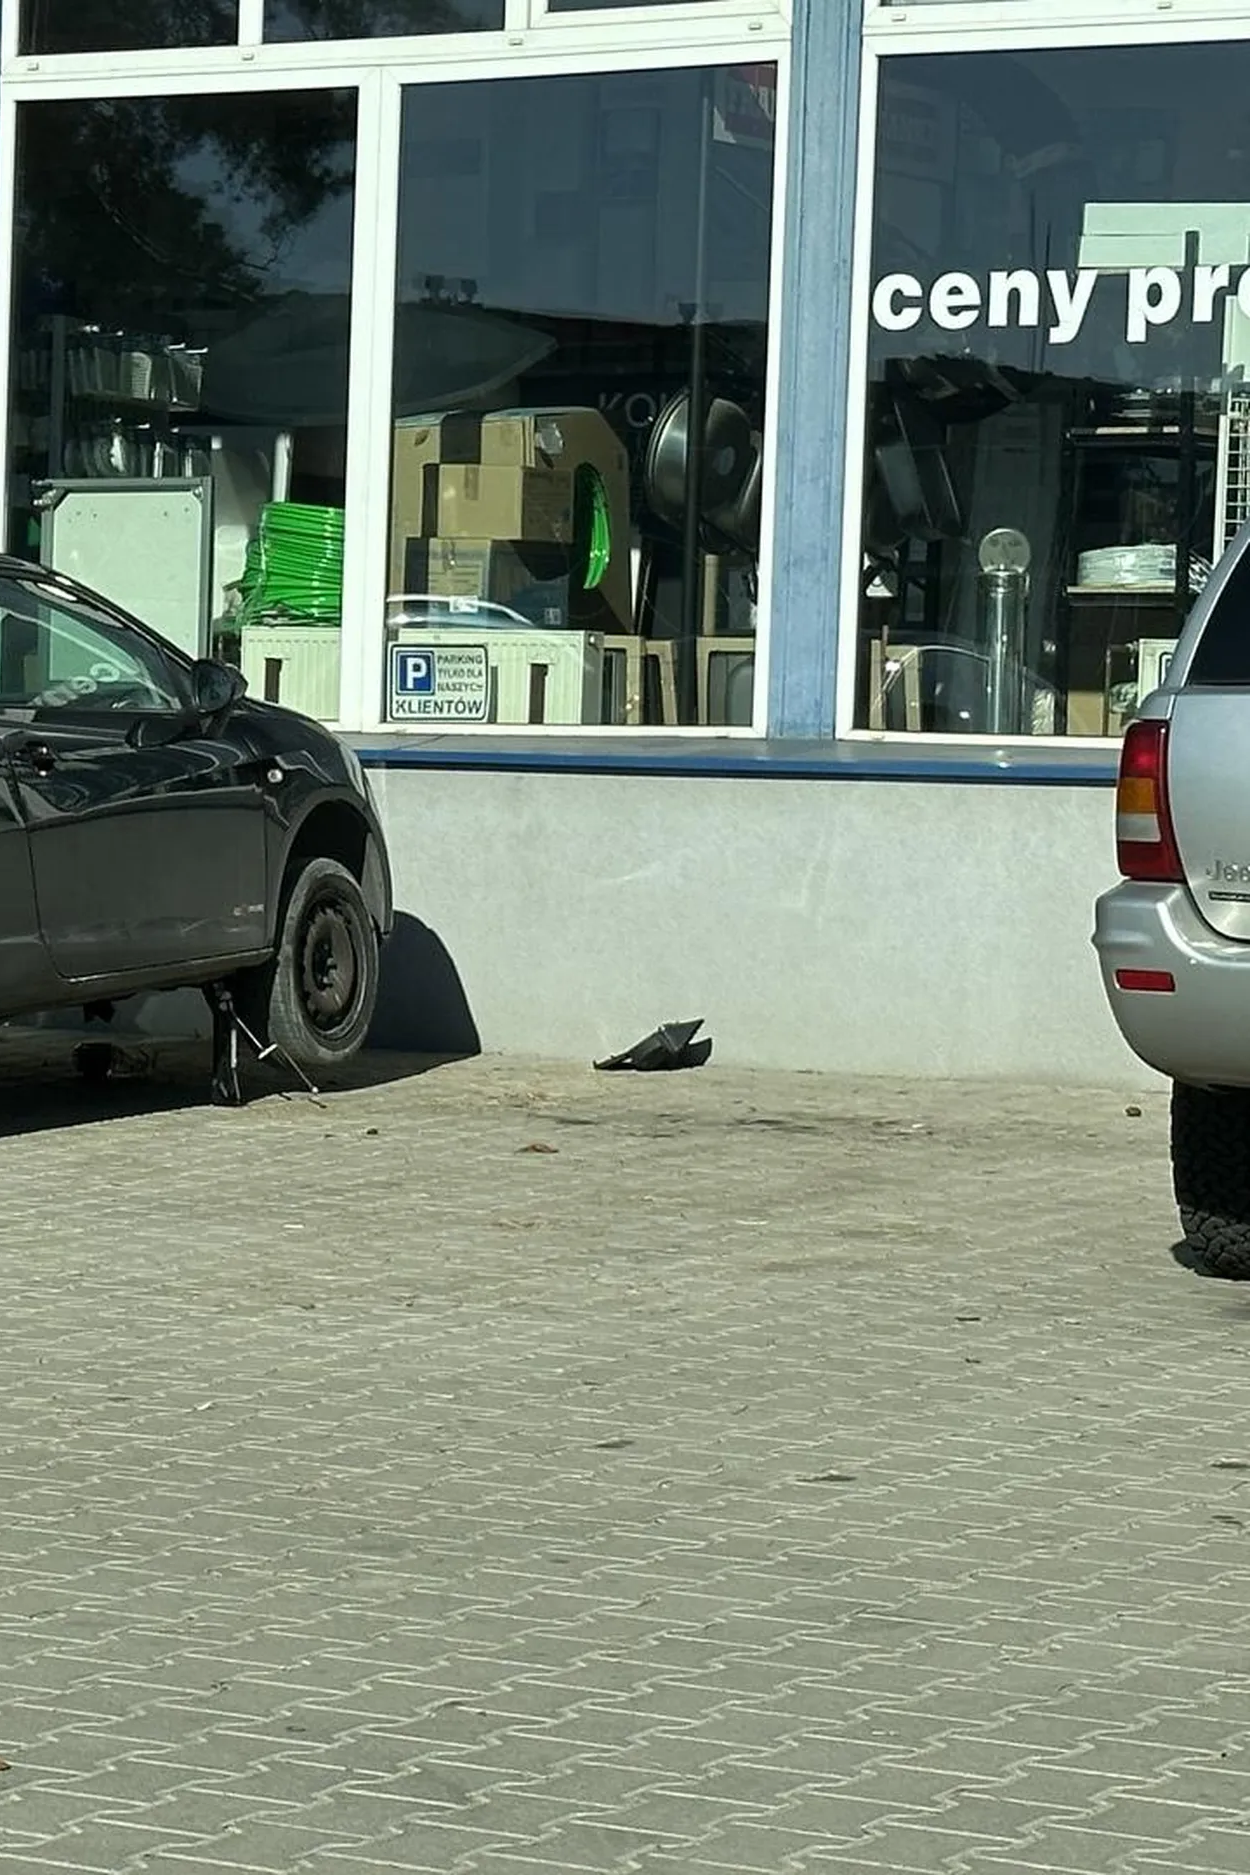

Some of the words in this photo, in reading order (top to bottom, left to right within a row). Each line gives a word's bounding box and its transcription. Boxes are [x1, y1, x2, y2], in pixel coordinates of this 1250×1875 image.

[872, 269, 1098, 344] ceny
[1126, 264, 1250, 343] pr
[437, 654, 483, 664] PARKING
[406, 657, 427, 689] P
[395, 696, 483, 714] KLIENTÓW
